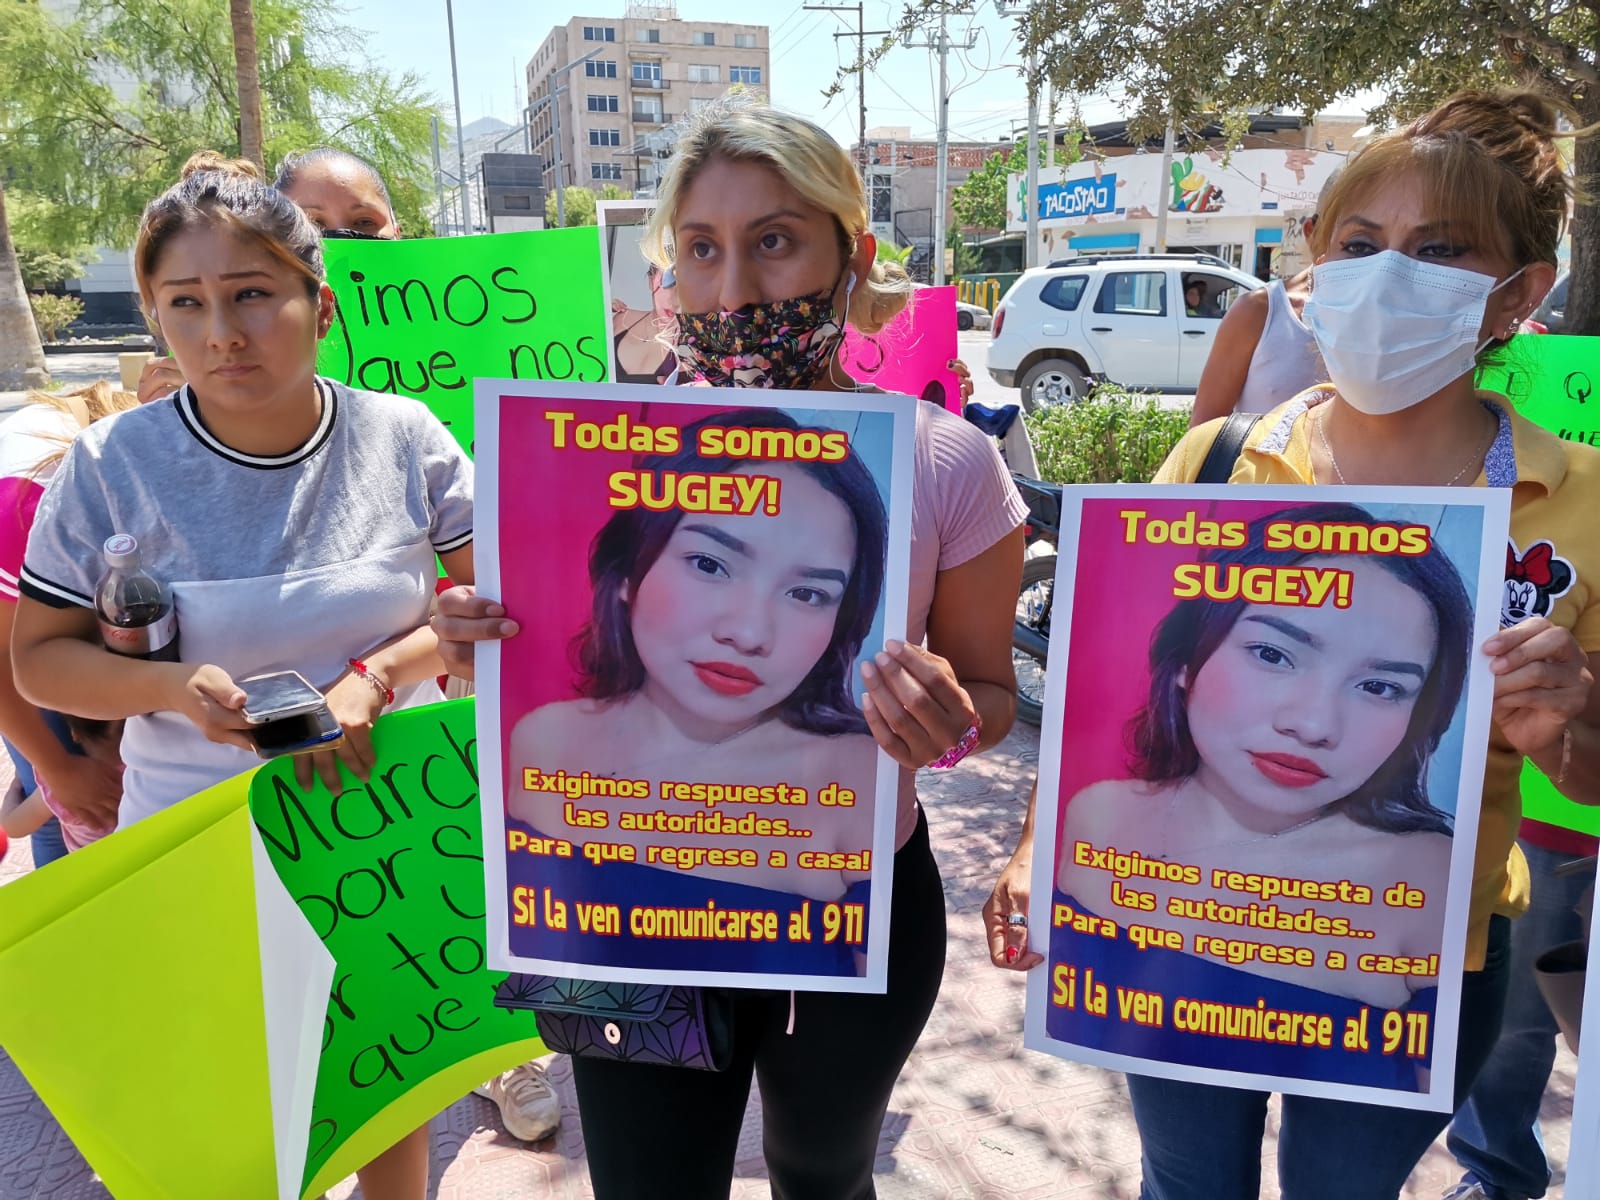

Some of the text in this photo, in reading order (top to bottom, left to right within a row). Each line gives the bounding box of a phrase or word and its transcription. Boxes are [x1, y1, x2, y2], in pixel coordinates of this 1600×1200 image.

[1045, 186, 1108, 216] TACOSTAO
[357, 335, 606, 395] que nos
[544, 410, 846, 461] Todas somos
[608, 470, 779, 515] SUGEY!
[1120, 510, 1428, 555] Todas somos
[1173, 563, 1351, 607] SUGEY!
[523, 767, 855, 808] Exigimos respuesta de
[564, 803, 811, 838] las autoridades...
[508, 830, 871, 871] Para que regrese a casa!
[1074, 841, 1424, 908] Exigimos respuesta de
[512, 886, 864, 943] Si la ven comunicarse al 911
[1112, 882, 1374, 938] las autoridades...
[1053, 904, 1439, 976] Para que regrese a casa!
[1052, 964, 1428, 1056] Si la ven comunicarse al 911
[349, 997, 481, 1089] que
